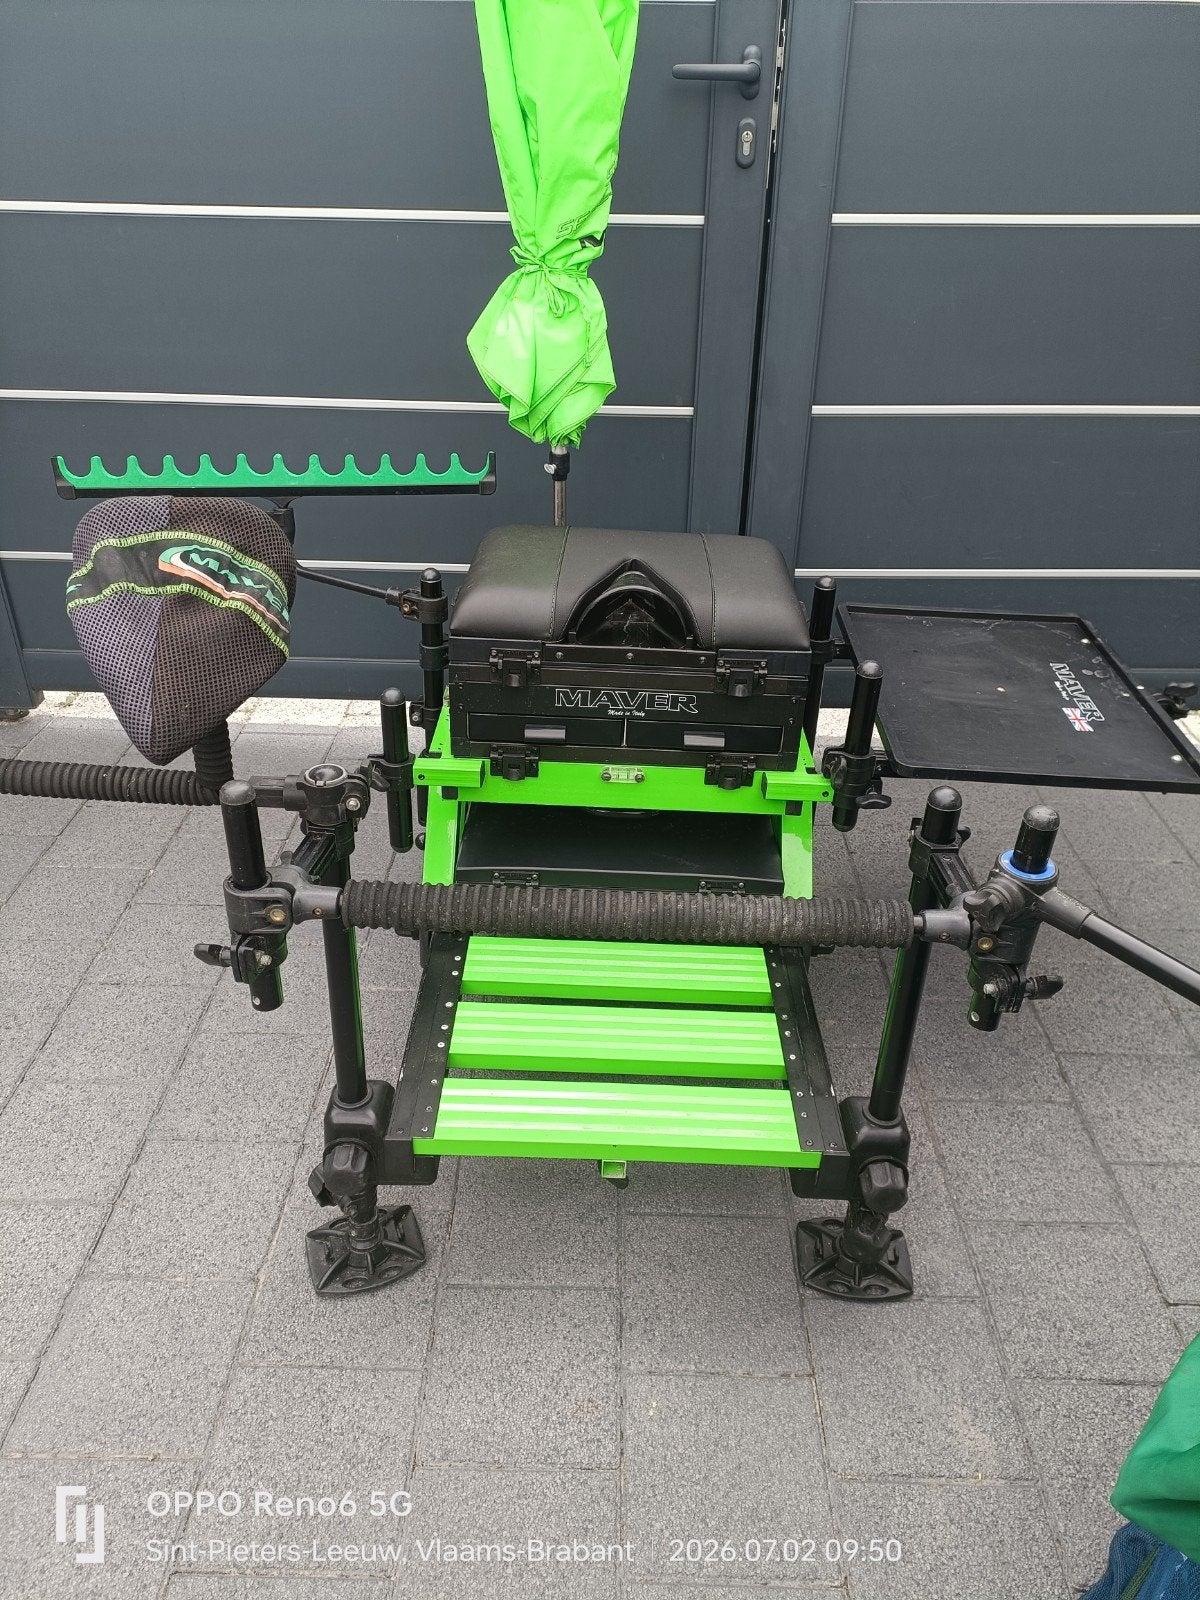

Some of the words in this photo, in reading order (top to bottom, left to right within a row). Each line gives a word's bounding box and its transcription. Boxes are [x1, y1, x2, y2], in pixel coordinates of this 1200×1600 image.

[555, 688, 699, 714] MAVER
[1049, 662, 1105, 721] MAVER
[631, 709, 646, 718] Italy
